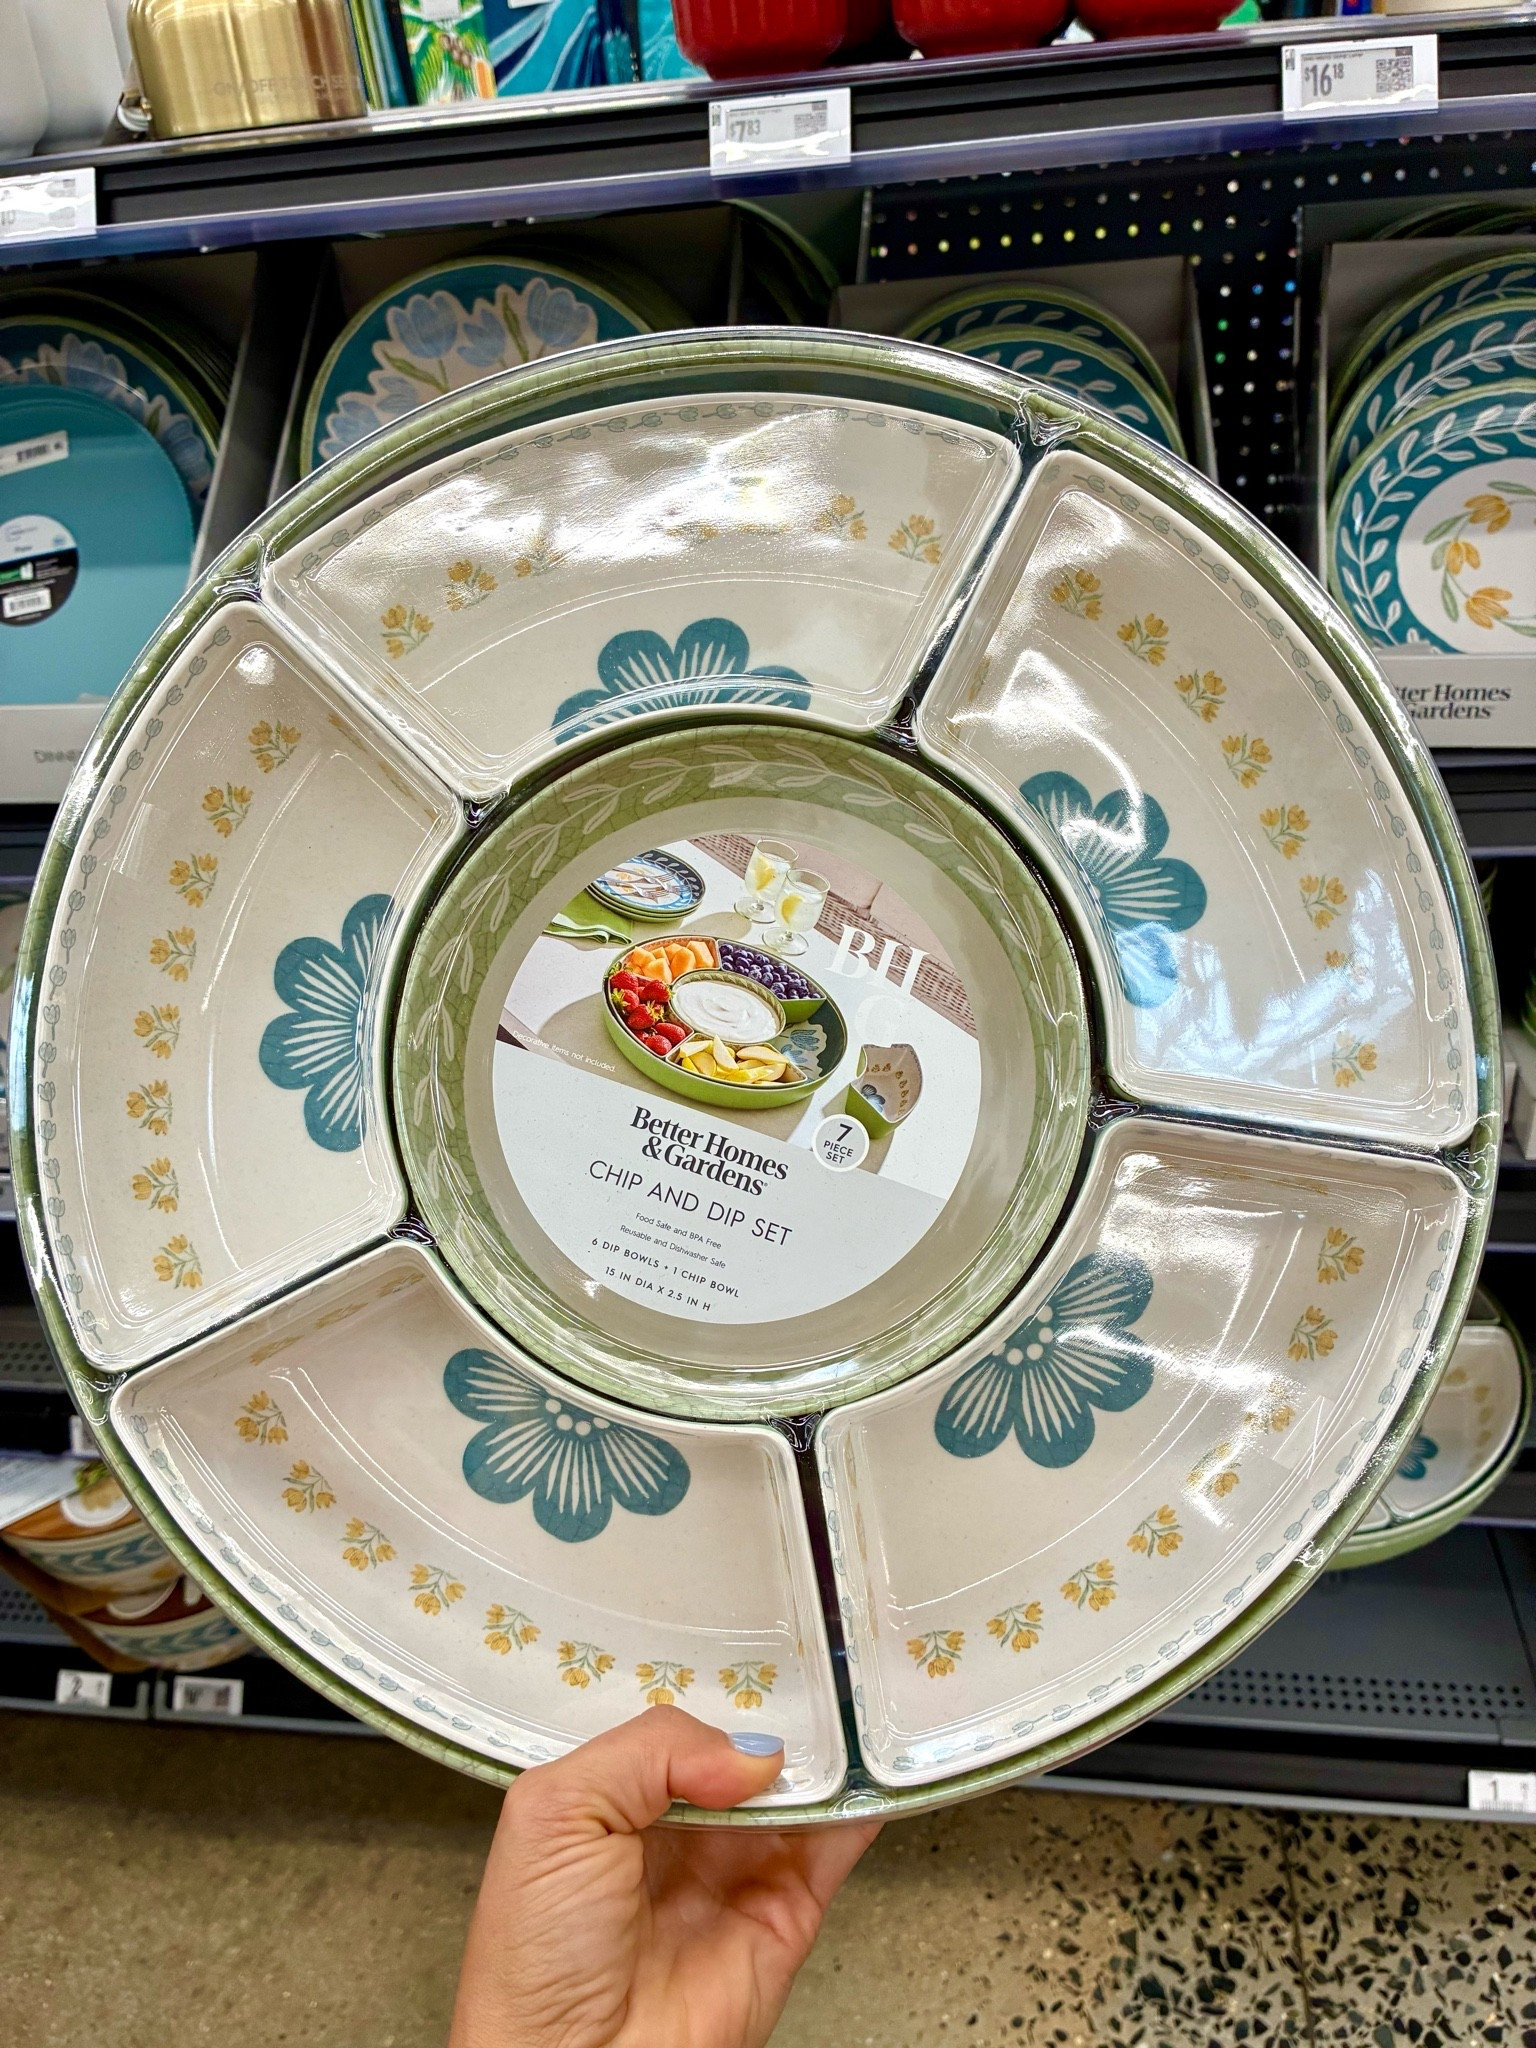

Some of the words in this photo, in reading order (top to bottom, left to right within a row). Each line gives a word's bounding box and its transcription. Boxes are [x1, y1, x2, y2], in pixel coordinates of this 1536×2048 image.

[1434, 684, 1511, 702] Homes
[512, 1030, 550, 1049] Decorative
[551, 1044, 570, 1056] items
[571, 1052, 584, 1061] not
[585, 1055, 616, 1073] included.
[630, 1105, 704, 1149] Better
[703, 1132, 789, 1180] Homes
[823, 1140, 854, 1158] PIECE
[836, 1123, 853, 1142] 7
[825, 1151, 845, 1164] SET
[589, 1160, 643, 1191] CHIP
[647, 1182, 700, 1212] AND
[707, 1201, 746, 1228] DIP
[751, 1218, 793, 1246] SET
[620, 1224, 652, 1242] Reusable
[653, 1237, 668, 1248] and
[669, 1242, 708, 1262] Dishwasher
[710, 1257, 727, 1269] Safe
[635, 1212, 655, 1225] Food
[656, 1218, 672, 1231] Safe
[673, 1227, 688, 1237] and
[689, 1231, 704, 1243] BPA
[705, 1238, 722, 1249] Free
[591, 1237, 598, 1246] 6
[602, 1241, 620, 1252] DIP
[623, 1249, 660, 1268] BOWLS
[672, 1266, 678, 1275] 1
[681, 1270, 707, 1284] CHIP
[710, 1281, 740, 1298] BOWL
[605, 1266, 616, 1277] 15
[619, 1271, 632, 1282] IN
[635, 1277, 653, 1291] DIA
[657, 1285, 665, 1294] X
[667, 1289, 683, 1301] 2.5
[687, 1296, 699, 1307] IN
[702, 1302, 711, 1312] H
